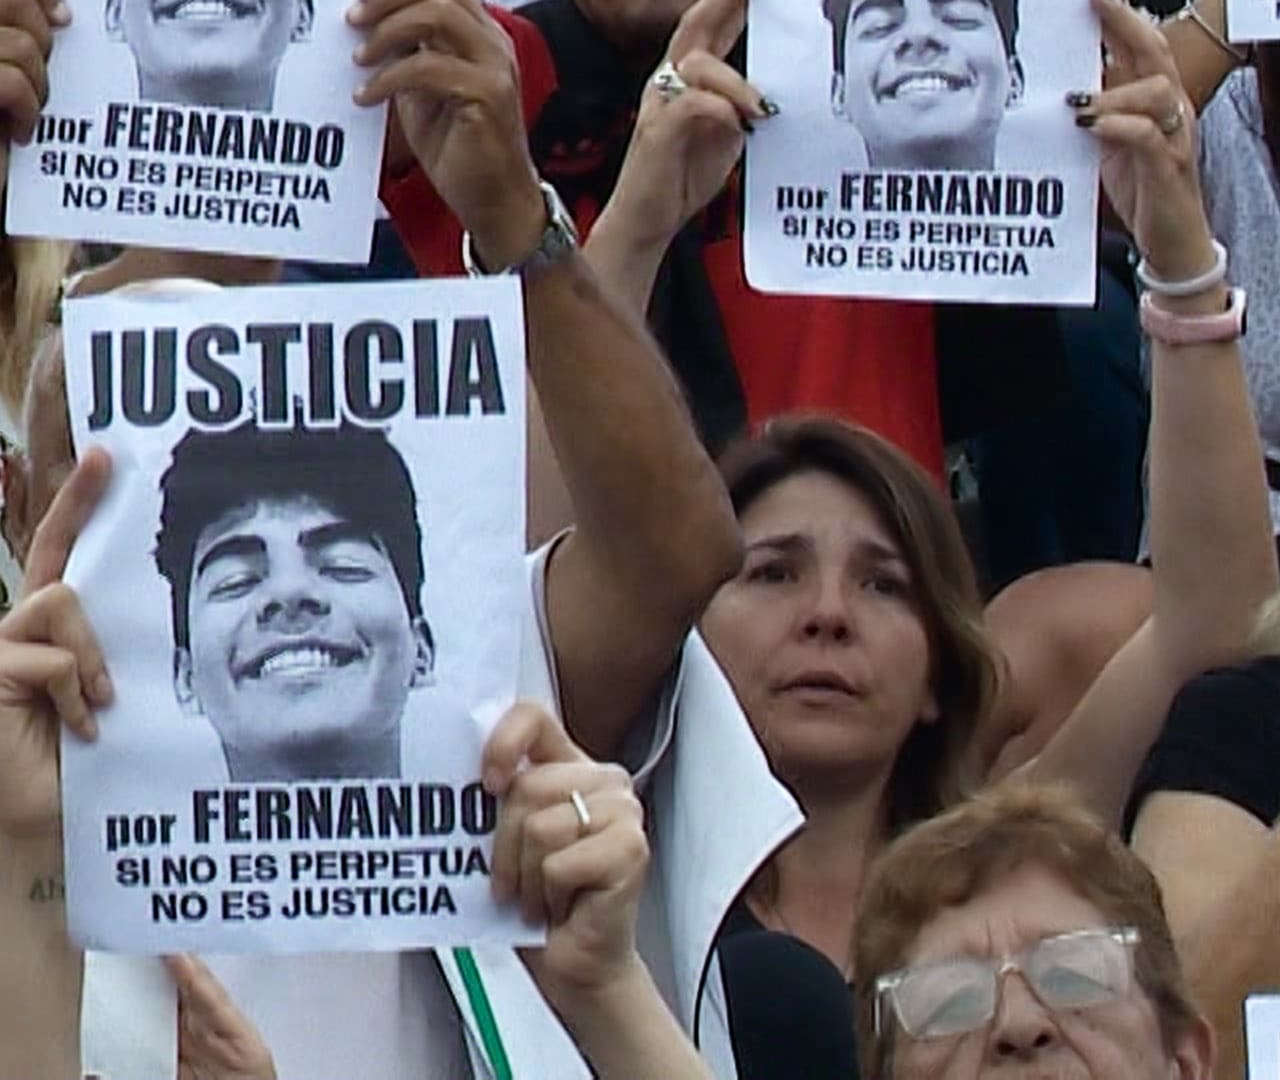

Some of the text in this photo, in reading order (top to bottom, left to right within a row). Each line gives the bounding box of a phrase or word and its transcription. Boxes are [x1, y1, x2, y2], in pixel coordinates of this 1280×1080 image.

[36, 103, 345, 170] por FERNANDO
[40, 151, 331, 203] SI NO ES PERPETUA
[776, 173, 1065, 219] por FERNANDO
[62, 183, 301, 230] NO ES JUSTICIA
[782, 216, 1055, 248] SI NO ES PERPETUA
[805, 244, 1029, 277] NO ES JUSTICIA
[88, 316, 506, 431] JUSTICIA
[106, 783, 498, 852] por FERNANDO
[116, 847, 491, 887] SI NO ES PERPETUA
[151, 885, 458, 921] NO ES JUSTICIA
